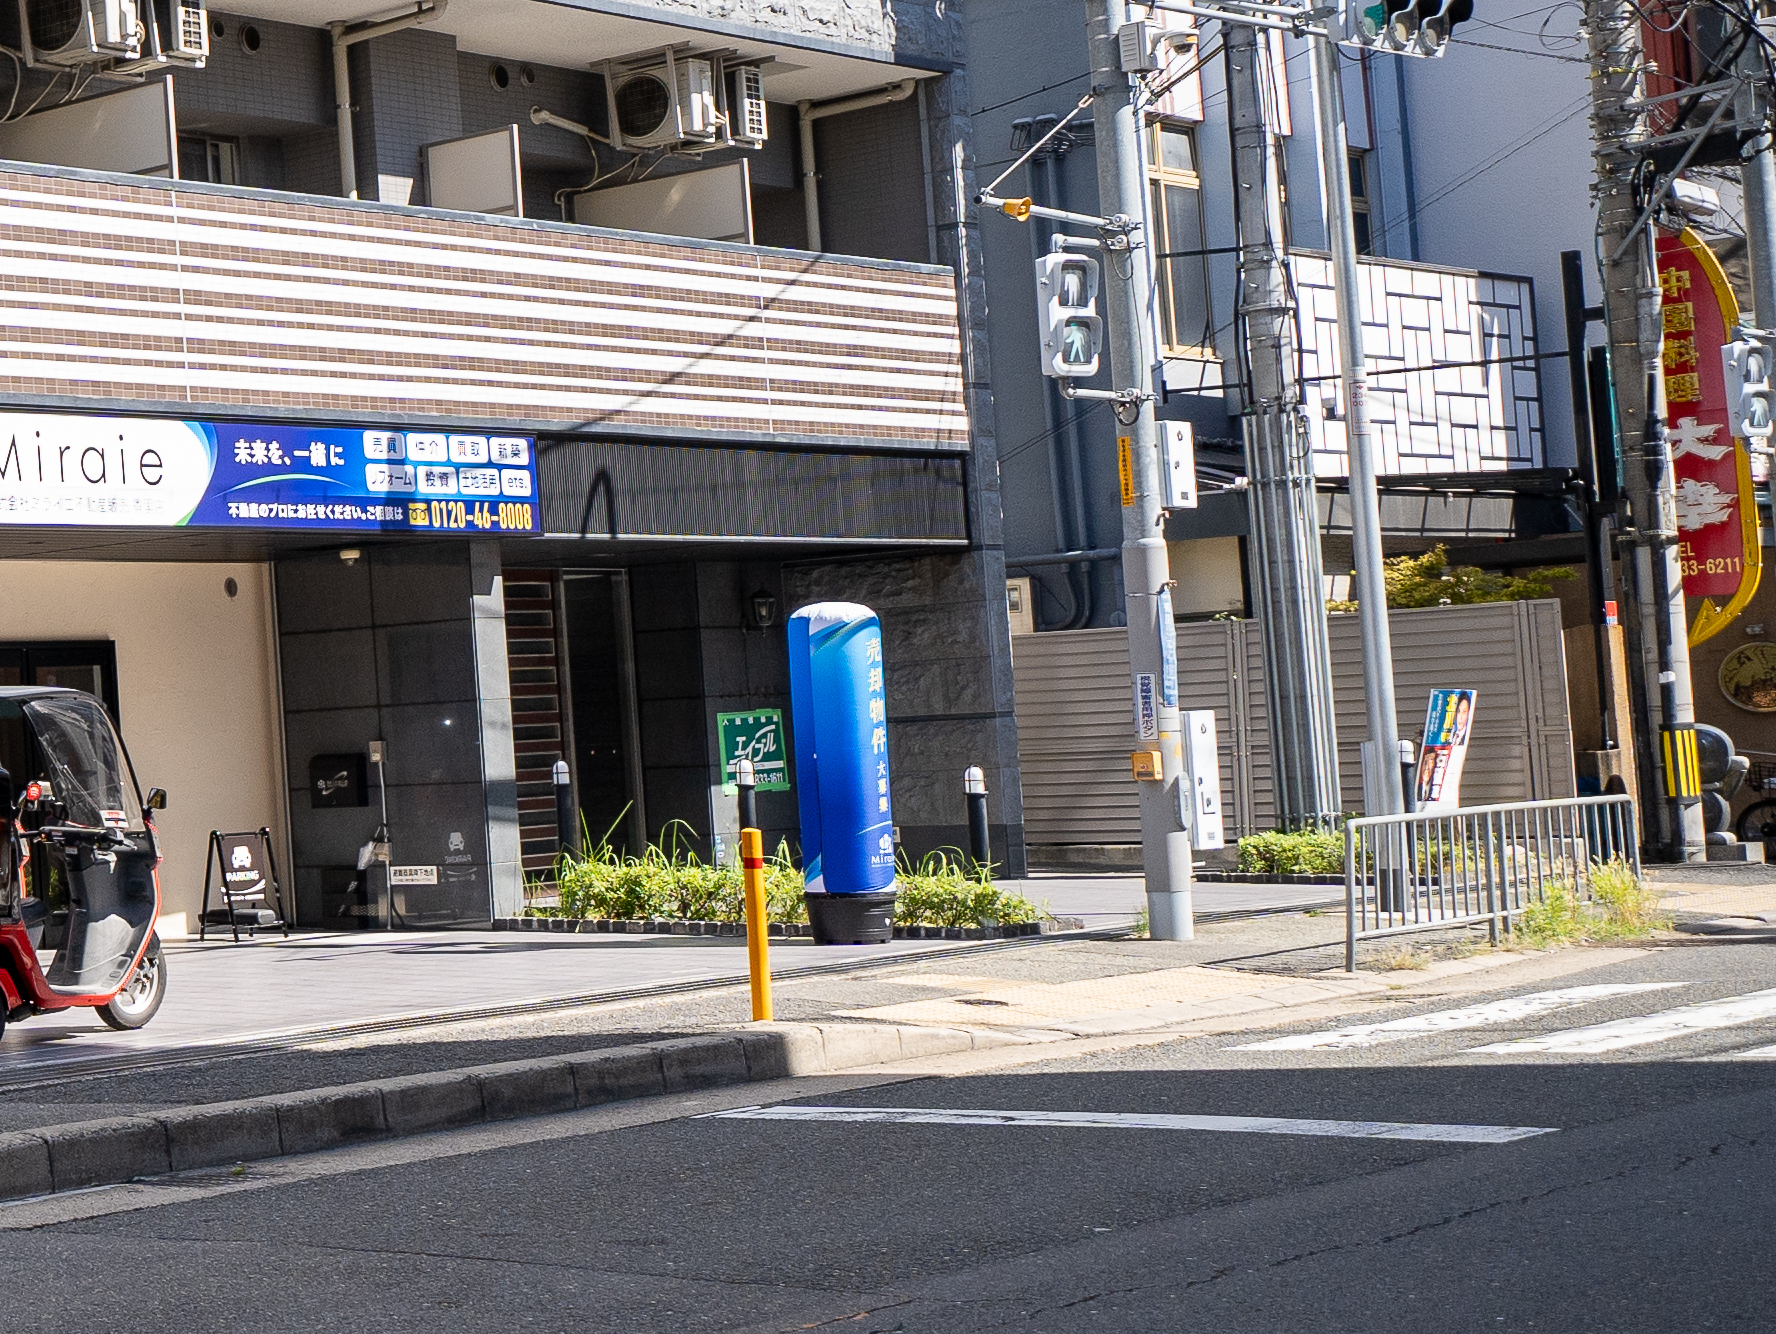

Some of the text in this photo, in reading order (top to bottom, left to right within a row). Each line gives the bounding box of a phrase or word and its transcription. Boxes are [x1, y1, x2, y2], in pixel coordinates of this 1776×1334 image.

[234, 439, 345, 467] 未来を、一緒に
[371, 469, 413, 486] リフォーム
[430, 500, 533, 530] 0120-46-8008
[1680, 556, 1741, 577] 33-6211
